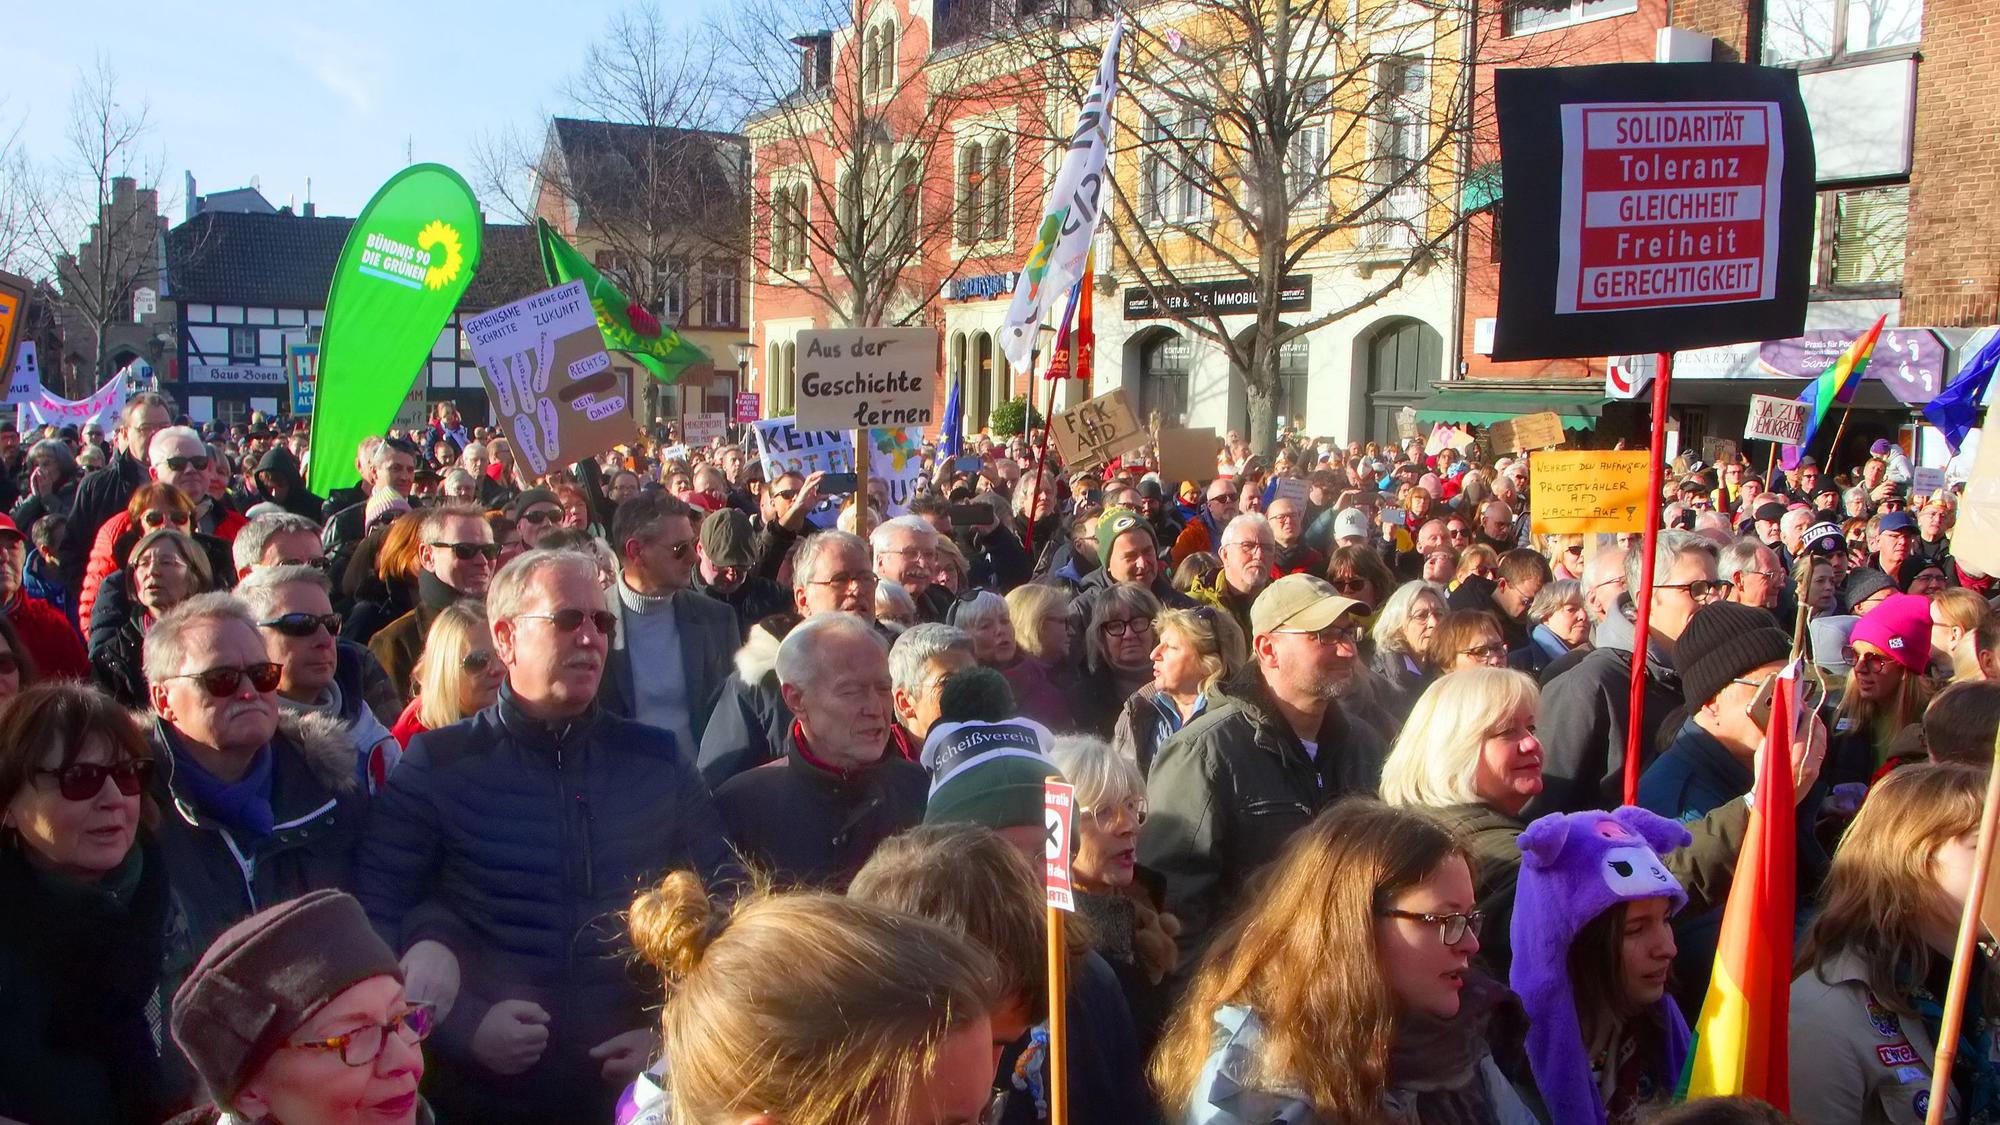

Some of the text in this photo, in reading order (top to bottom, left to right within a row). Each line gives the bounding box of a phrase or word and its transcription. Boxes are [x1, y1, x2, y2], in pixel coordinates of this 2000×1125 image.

[1616, 112, 1744, 144] SOLIDARITÄT
[1619, 154, 1739, 182] Toleranz
[1619, 192, 1738, 222] GLEICHHEIT
[366, 232, 431, 266] BÜNDNIS 90
[1617, 226, 1737, 260] Freiheit
[361, 249, 427, 281] DIE GRÜNEN
[1593, 263, 1754, 298] GERECHTIGKEIT
[527, 285, 580, 312] IN EINE GUTE
[466, 305, 521, 334] GEMEINSAME
[534, 300, 581, 326] ZUKUNFT
[477, 322, 518, 346] SCHRITTE
[807, 336, 896, 358] Aus der
[569, 355, 607, 377] RECHTS
[1801, 356, 1836, 368] Sandr
[801, 370, 922, 398] Geschichte
[573, 393, 594, 409] NEIN
[589, 400, 623, 420] DANKE
[854, 401, 931, 427] lernen
[1756, 400, 1773, 418] JA
[1537, 461, 1575, 473] WEHRET
[1802, 523, 1836, 545] TUNA
[935, 731, 1035, 771] Scheißverein
